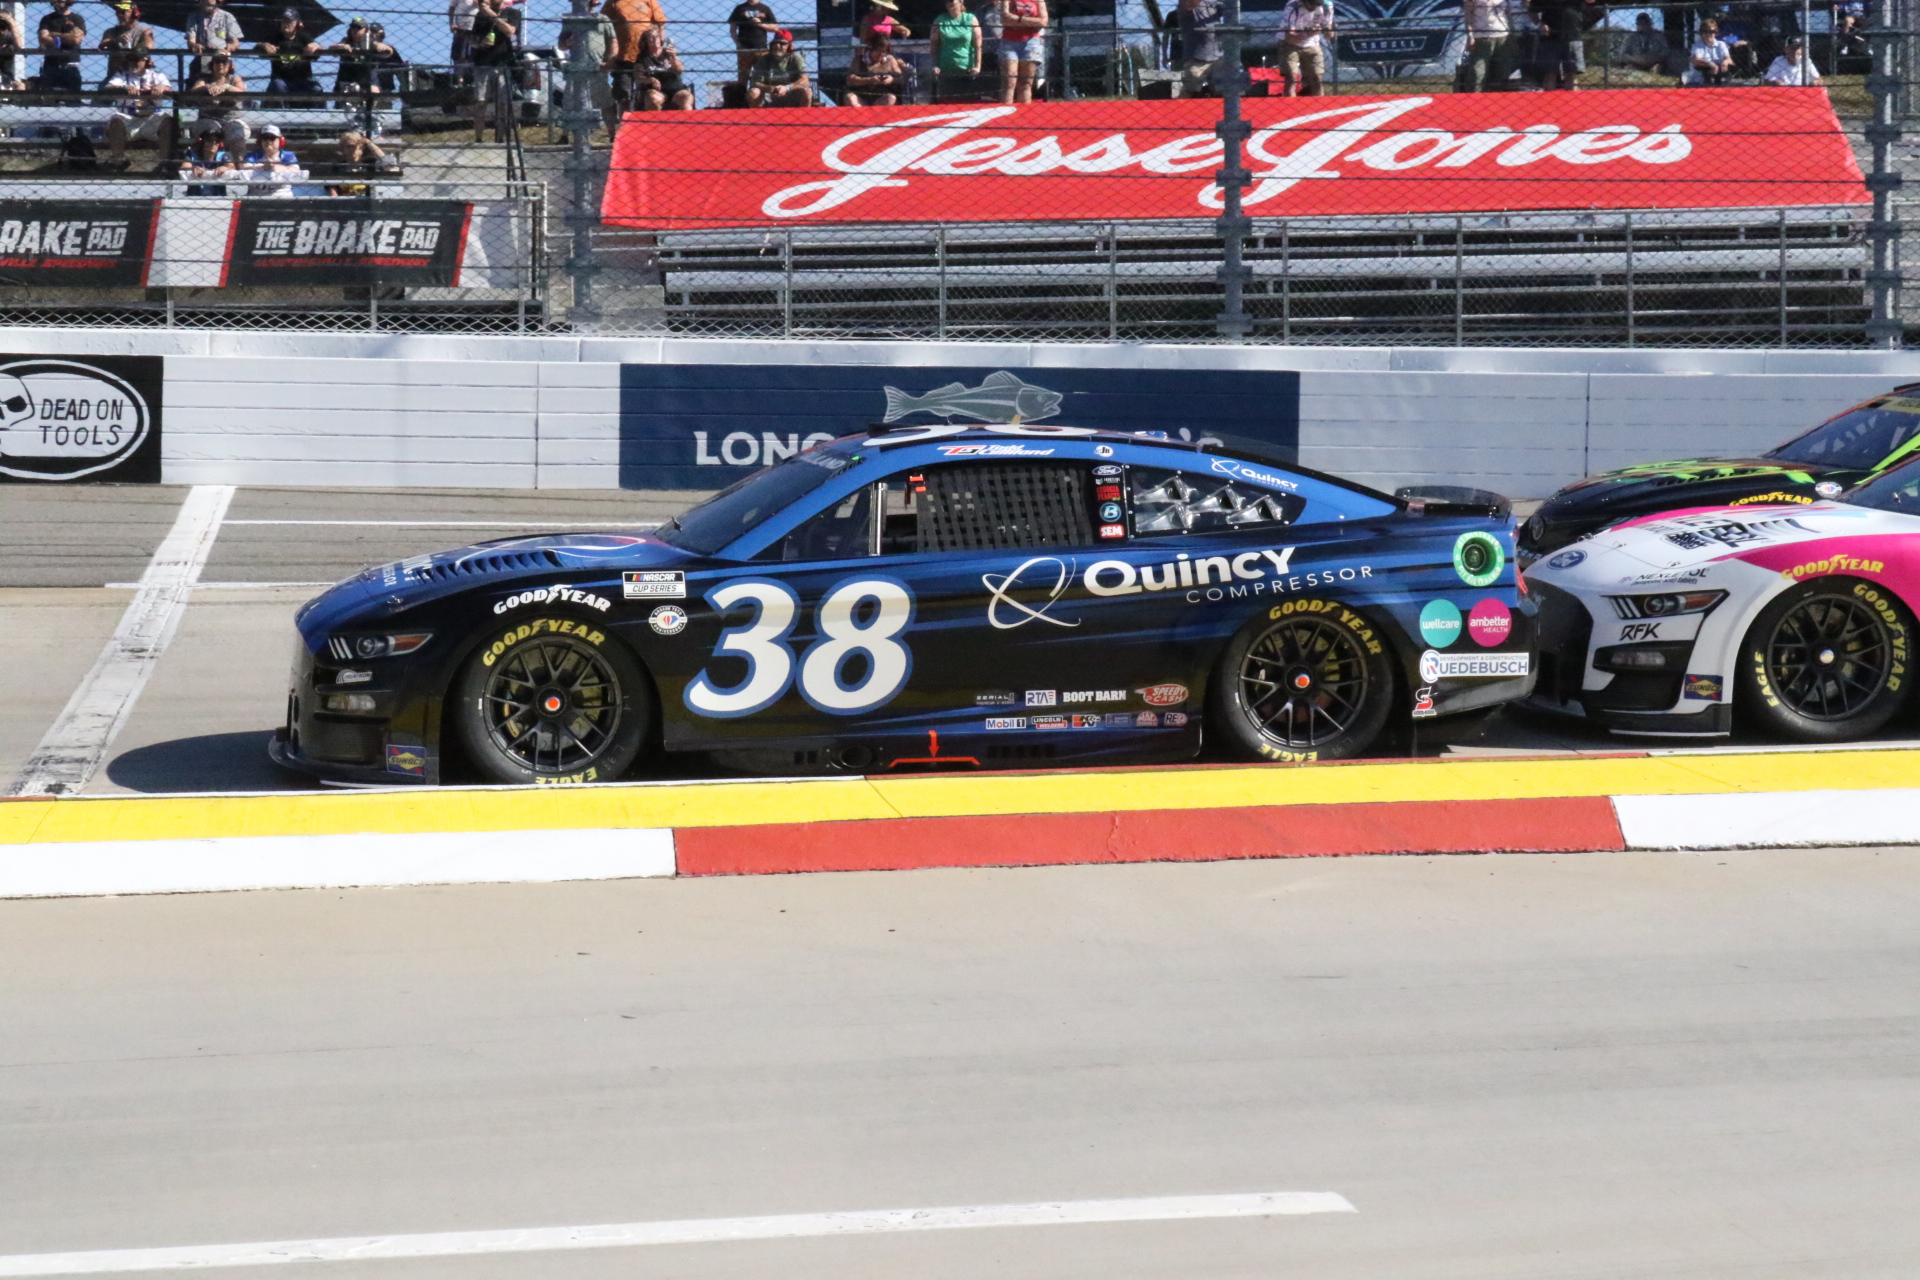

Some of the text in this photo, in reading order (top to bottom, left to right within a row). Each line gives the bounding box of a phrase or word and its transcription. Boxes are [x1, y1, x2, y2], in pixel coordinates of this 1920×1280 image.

[762, 106, 1225, 217] Jesse
[1197, 97, 1692, 210] Jones
[86, 227, 128, 249] PAD
[255, 220, 440, 255] THE BRAKE PAD
[40, 398, 123, 421] DEAD ON
[38, 424, 123, 446] TOOLS
[1241, 468, 1299, 489] Quincy
[1729, 492, 1813, 506] GOODYEAR
[1101, 526, 1123, 537] SEM
[1084, 547, 1295, 597] Quincy
[1781, 554, 1884, 580] GOODYEAR
[643, 573, 675, 581] NASCAR
[1186, 566, 1372, 603] COMPRESSOR
[632, 584, 677, 593] CUP SERIES
[493, 584, 611, 614] GOODYEAR
[1269, 599, 1382, 655] GOODYEAR
[1422, 618, 1460, 629] wellcare
[1470, 616, 1509, 627] ambetter
[1619, 623, 1661, 641] RFK
[1853, 583, 1907, 692] GOODYEAR
[483, 619, 605, 667] GOODYEAR
[684, 575, 915, 717] 38
[1425, 657, 1527, 675] RUEDEBUSCH
[1687, 684, 1721, 692] SUNOCO
[1754, 651, 1780, 707] EAGLE
[1027, 691, 1049, 704] RTA
[1063, 690, 1126, 702] BOOT BARN
[1152, 687, 1187, 697] SPEEDY
[1153, 695, 1183, 703] CASH
[987, 719, 1015, 728] Mobil
[390, 756, 425, 766] SUNOCO
[1258, 743, 1318, 762] EAGLE
[535, 767, 597, 784] EAGLE
